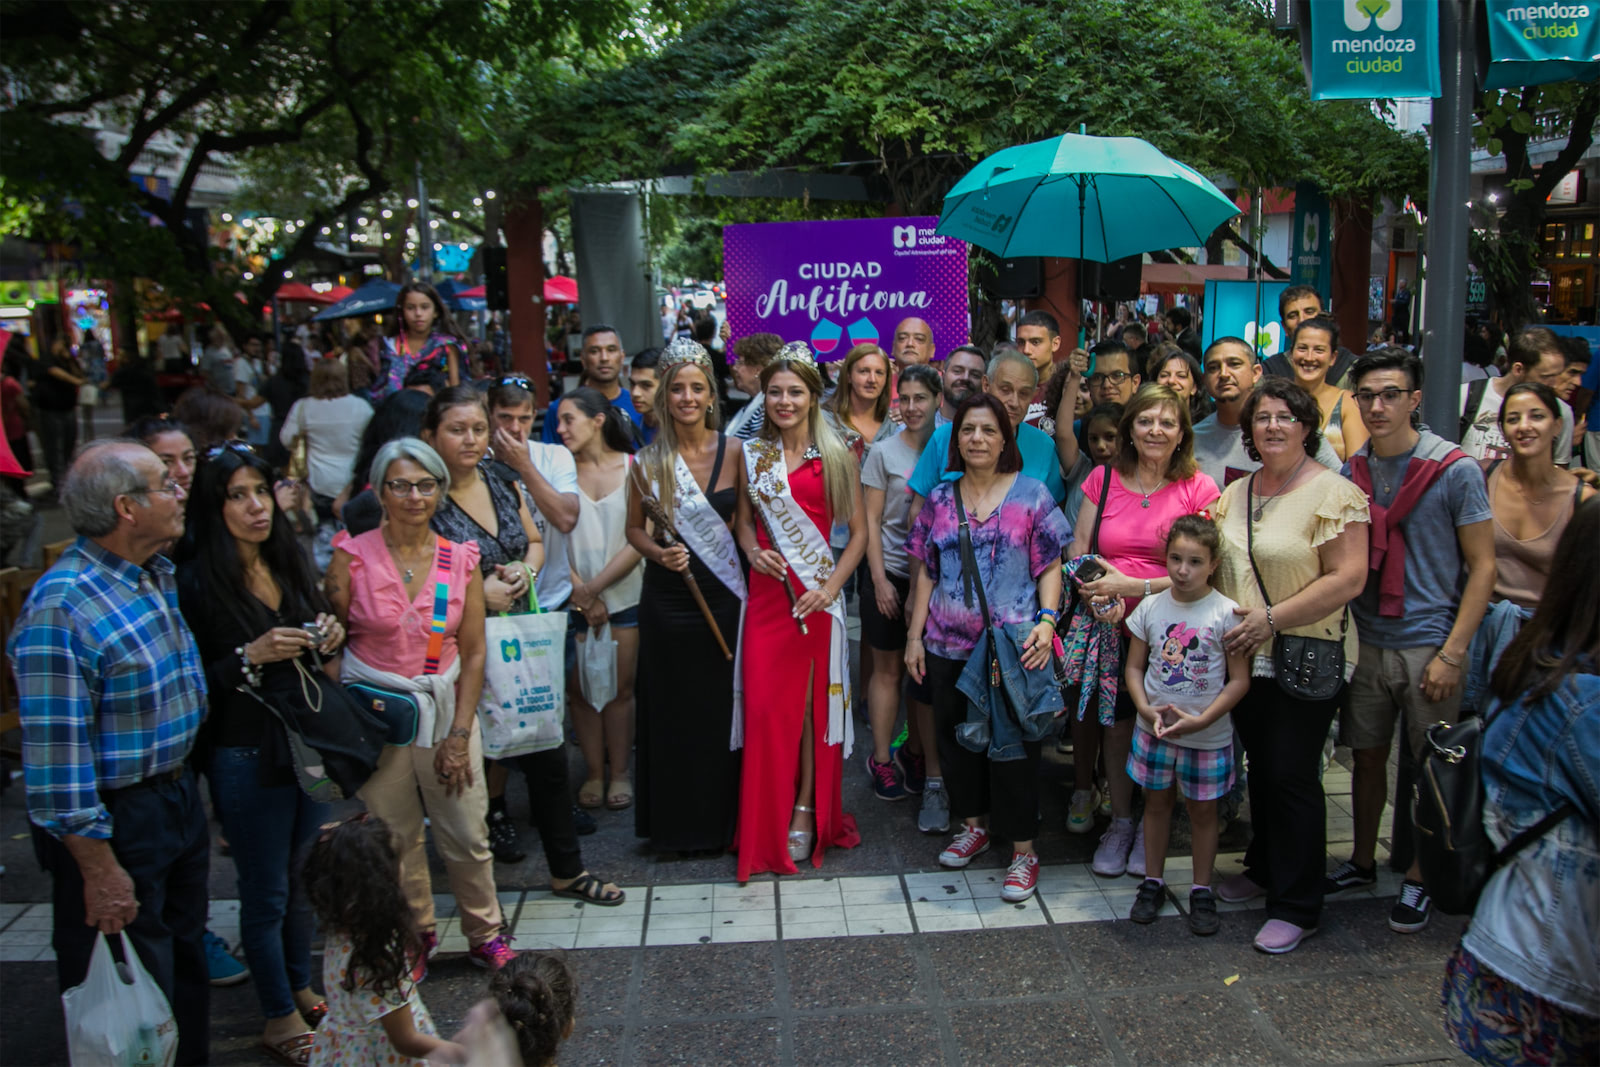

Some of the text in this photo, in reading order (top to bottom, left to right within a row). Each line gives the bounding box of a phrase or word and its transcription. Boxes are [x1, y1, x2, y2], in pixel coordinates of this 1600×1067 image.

[1507, 2, 1590, 22] mendoza
[1523, 22, 1580, 40] ciudad
[1331, 35, 1416, 54] mendoza
[1346, 56, 1403, 74] ciudad
[918, 235, 946, 245] ciudad
[798, 262, 883, 280] CIUDAD
[756, 278, 933, 322] Anfitriona
[1468, 282, 1486, 303] 599
[679, 500, 729, 560] CIUDAD
[767, 495, 819, 565] CIUDAD
